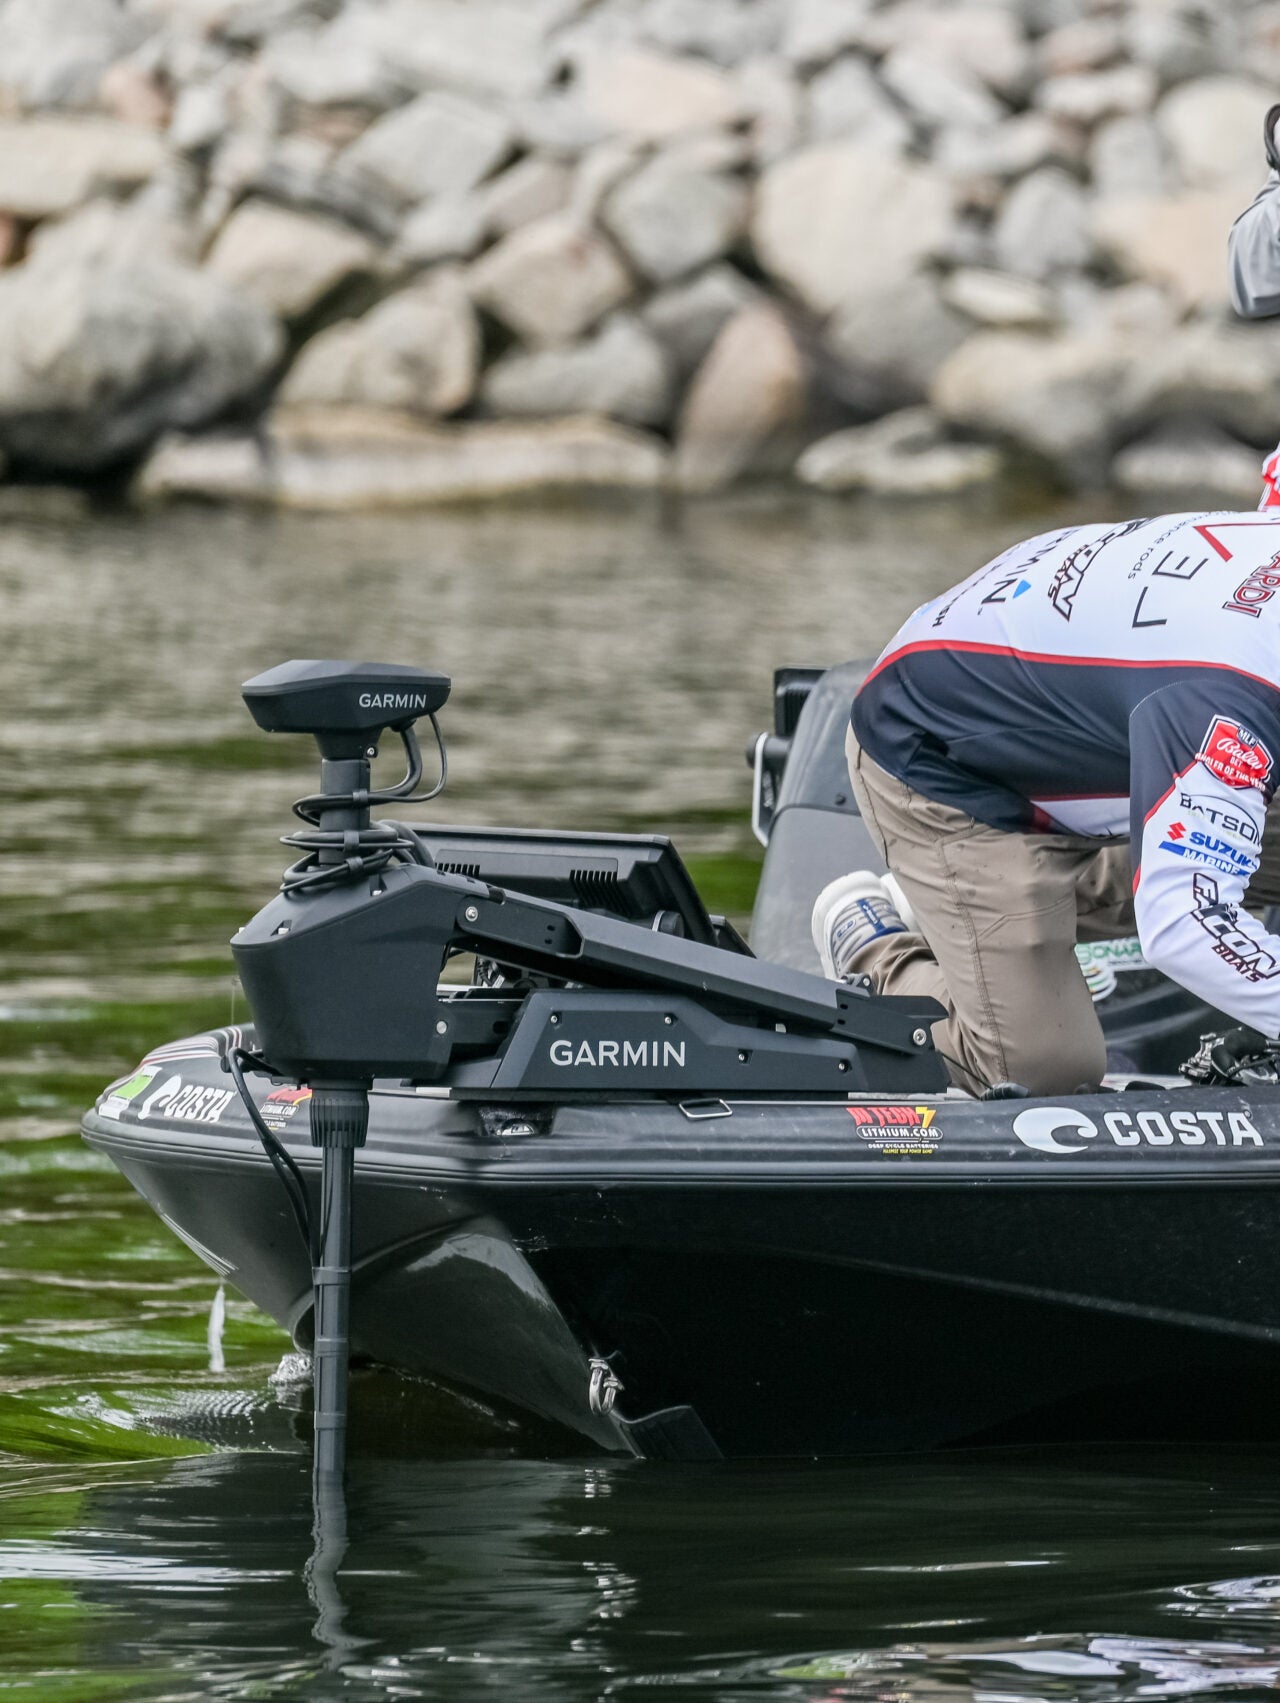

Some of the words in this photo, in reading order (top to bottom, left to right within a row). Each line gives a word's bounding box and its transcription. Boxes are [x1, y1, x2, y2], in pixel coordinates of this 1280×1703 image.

[1127, 547, 1156, 581] rods
[358, 693, 427, 709] GARMIN
[1238, 729, 1257, 746] MLF
[1216, 737, 1263, 770] Bally
[1223, 765, 1235, 778] OF
[1235, 769, 1250, 784] THE
[549, 1039, 687, 1068] GARMIN
[163, 1084, 237, 1123] COSTA
[861, 1128, 939, 1137] LITHIUM.COM
[1103, 1110, 1265, 1148] COSTA
